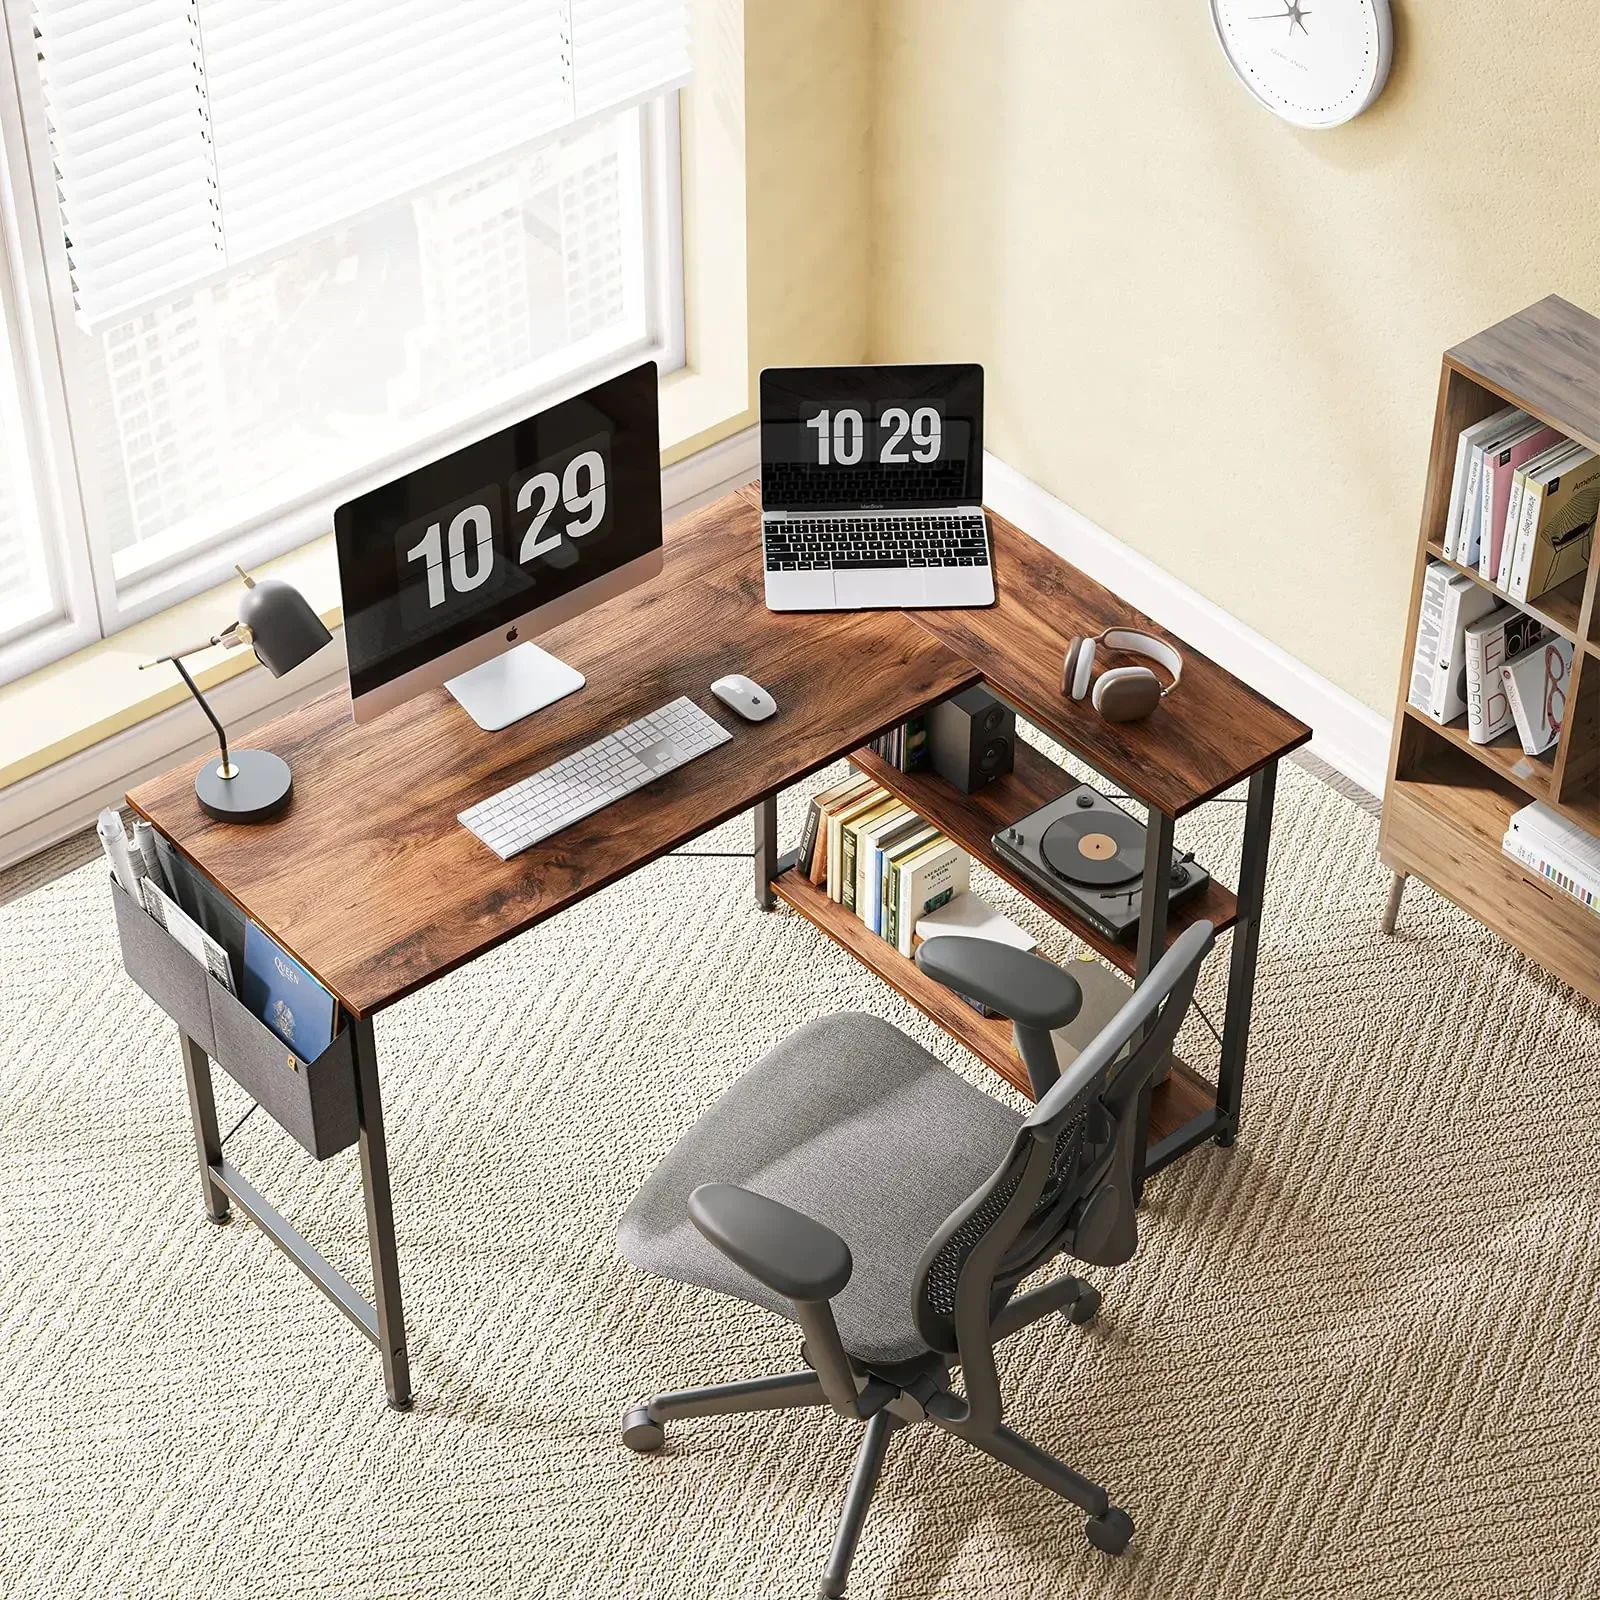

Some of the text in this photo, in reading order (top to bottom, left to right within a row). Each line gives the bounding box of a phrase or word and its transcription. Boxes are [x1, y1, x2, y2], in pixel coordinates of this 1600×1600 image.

[807, 407, 942, 465] 10 29
[407, 450, 606, 608] 10 29
[1522, 518, 1533, 537] Design
[1423, 574, 1446, 619] THE
[1416, 617, 1440, 666] ART
[274, 956, 299, 985] QUEEN
